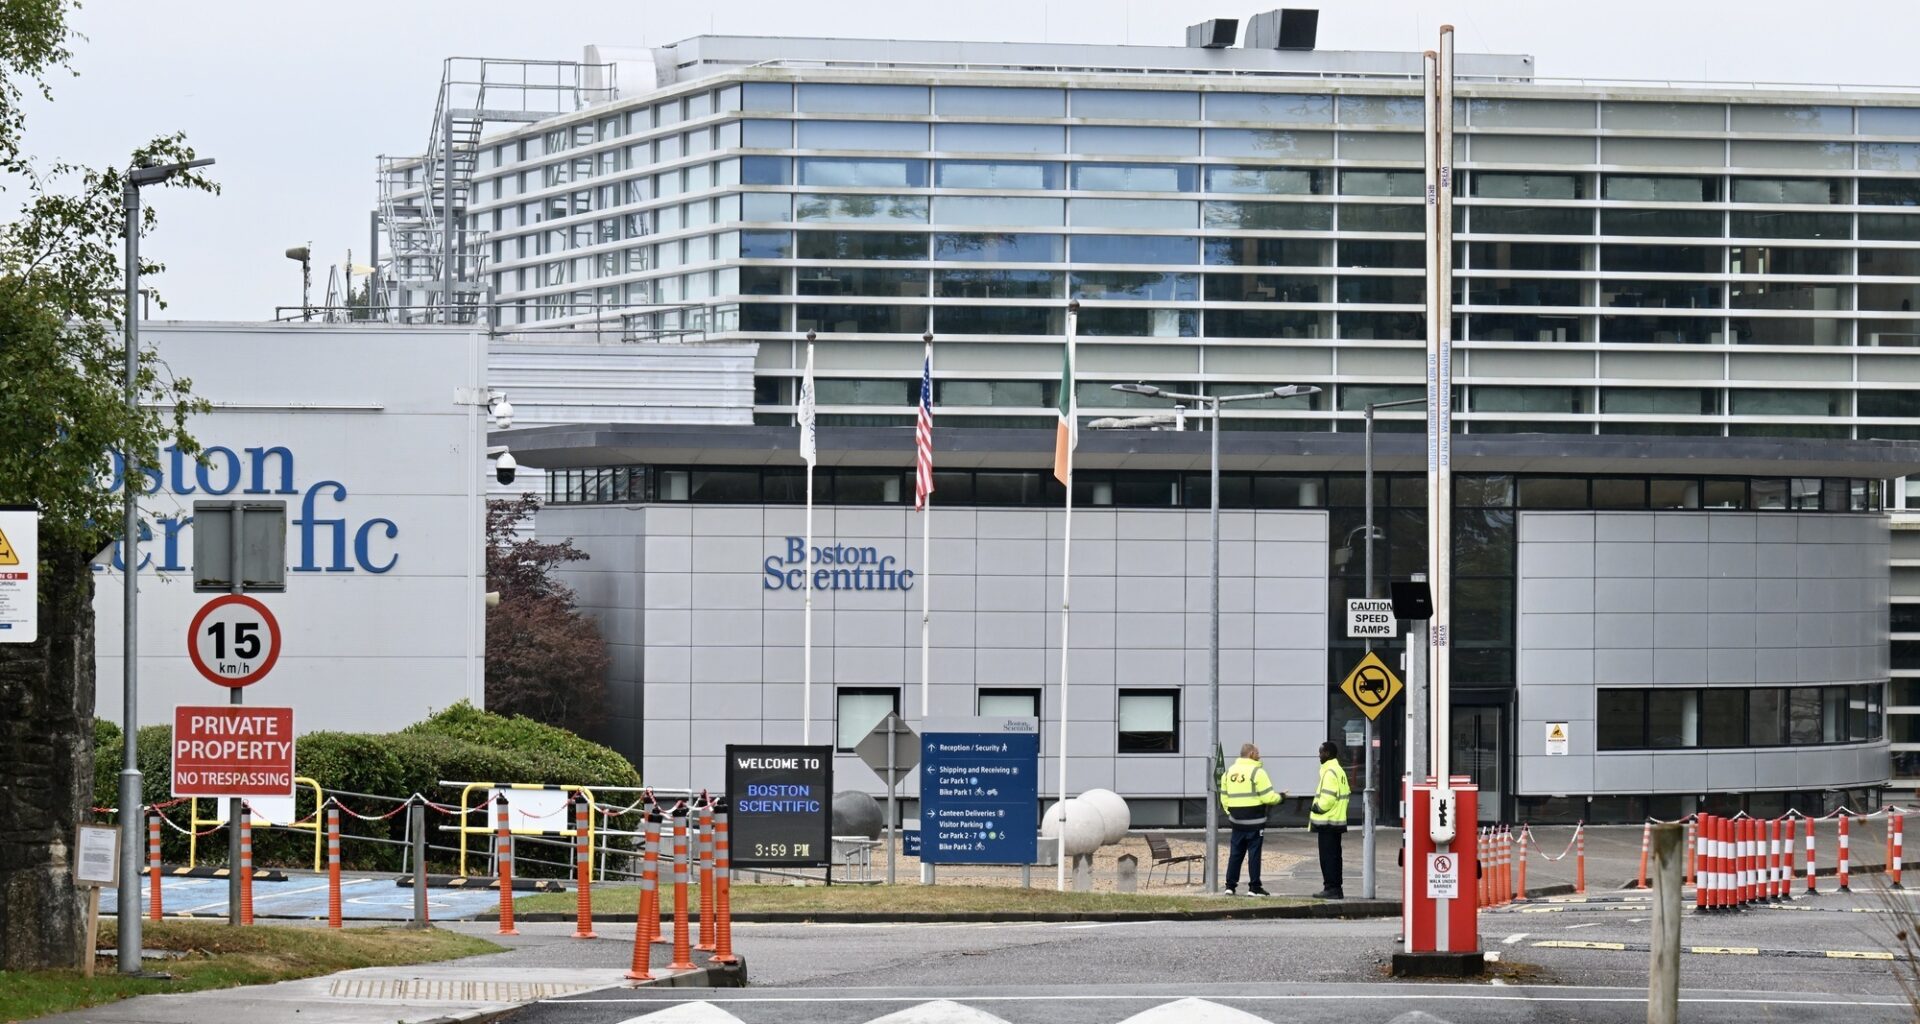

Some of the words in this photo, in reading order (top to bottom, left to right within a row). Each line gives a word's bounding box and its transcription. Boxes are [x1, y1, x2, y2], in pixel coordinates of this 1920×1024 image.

[785, 536, 879, 565] Boston
[1350, 602, 1393, 611] CAUTION
[1355, 614, 1389, 623] SPEED
[1353, 625, 1390, 634] RAMPS
[207, 621, 261, 660] 15
[219, 662, 250, 675] km/h
[191, 715, 278, 736] PRIVATE
[177, 740, 291, 760] PROPERTY
[940, 744, 970, 752] Reception
[975, 744, 1000, 753] Security
[738, 758, 799, 769] WELCOME
[803, 758, 820, 769] TO
[939, 766, 967, 775] Shipping
[981, 766, 1010, 775] Receiving
[177, 772, 198, 785] NO
[200, 772, 289, 787] TRESPASSING
[748, 785, 810, 797] BOSTON
[739, 800, 820, 812] SCIENTIFIC
[960, 821, 984, 829] Parking
[755, 843, 787, 857] 3:59
[793, 843, 810, 857] PM
